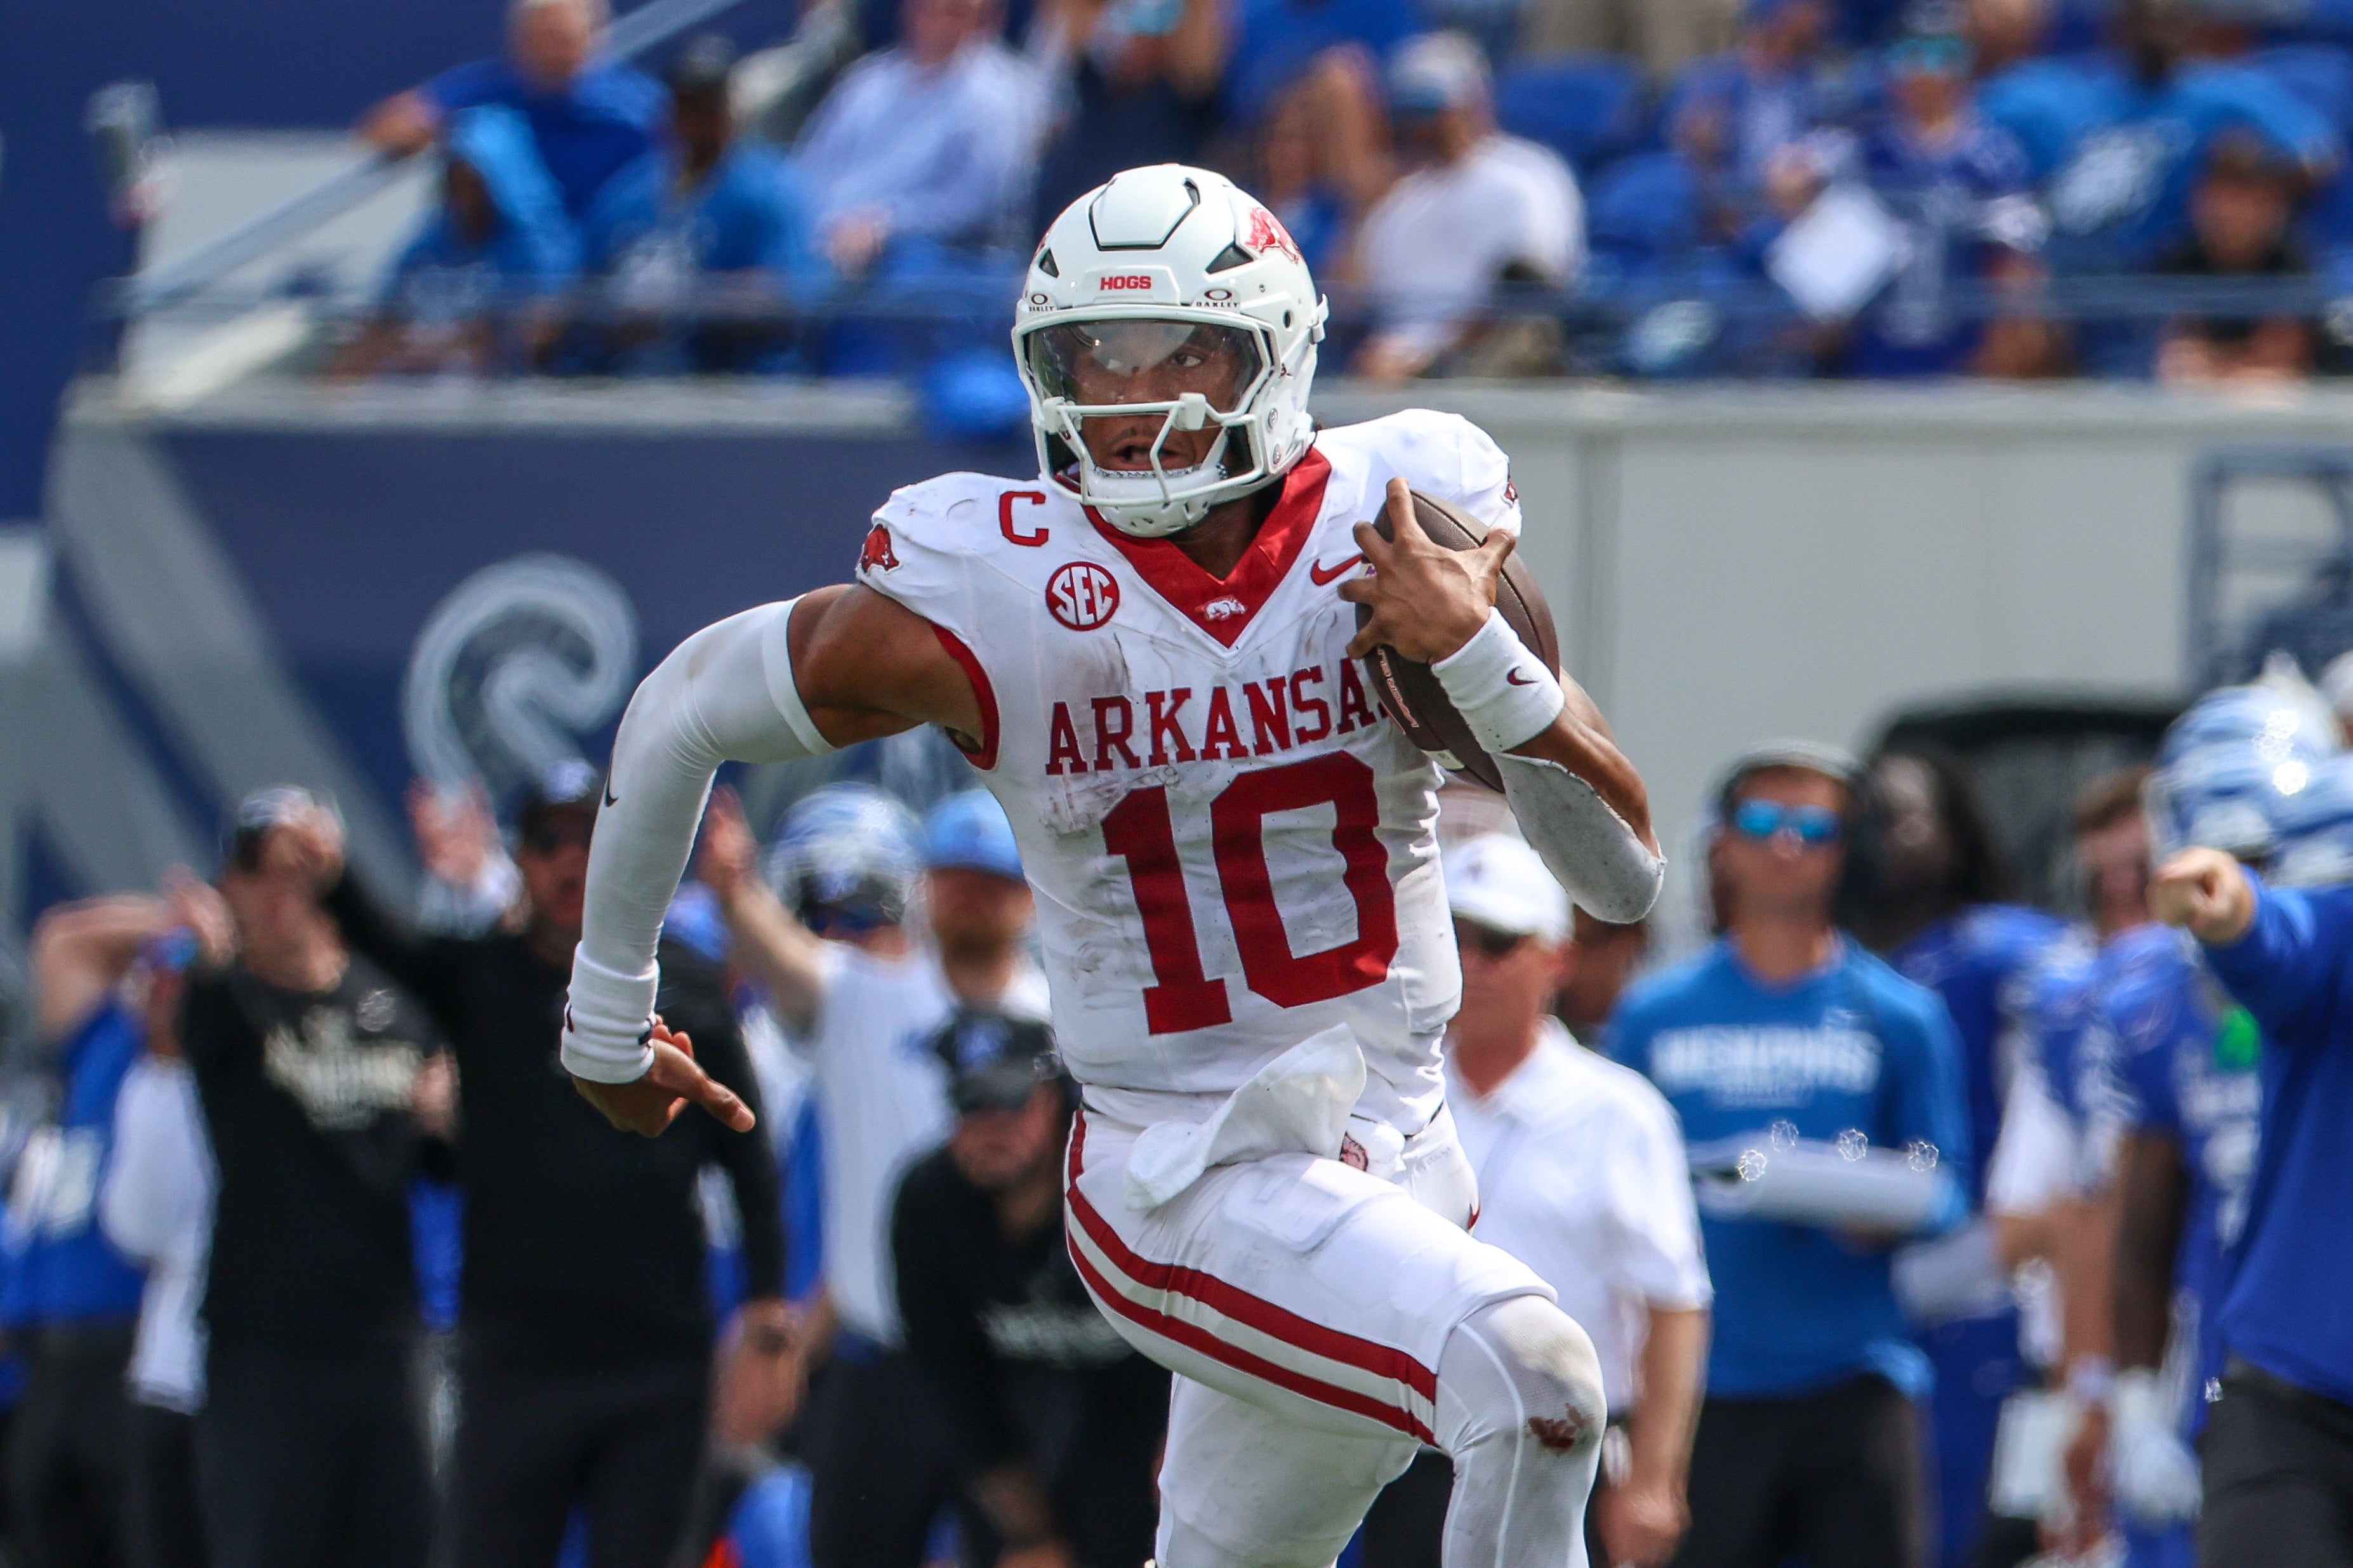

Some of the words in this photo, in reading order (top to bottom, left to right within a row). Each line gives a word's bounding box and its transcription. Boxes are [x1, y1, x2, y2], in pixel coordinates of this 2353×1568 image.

[1099, 275, 1152, 291] HOGS
[998, 491, 1049, 547] C
[1051, 565, 1114, 626] SEC
[1045, 657, 1389, 775] ARKANSA
[1100, 750, 1400, 1036] 10
